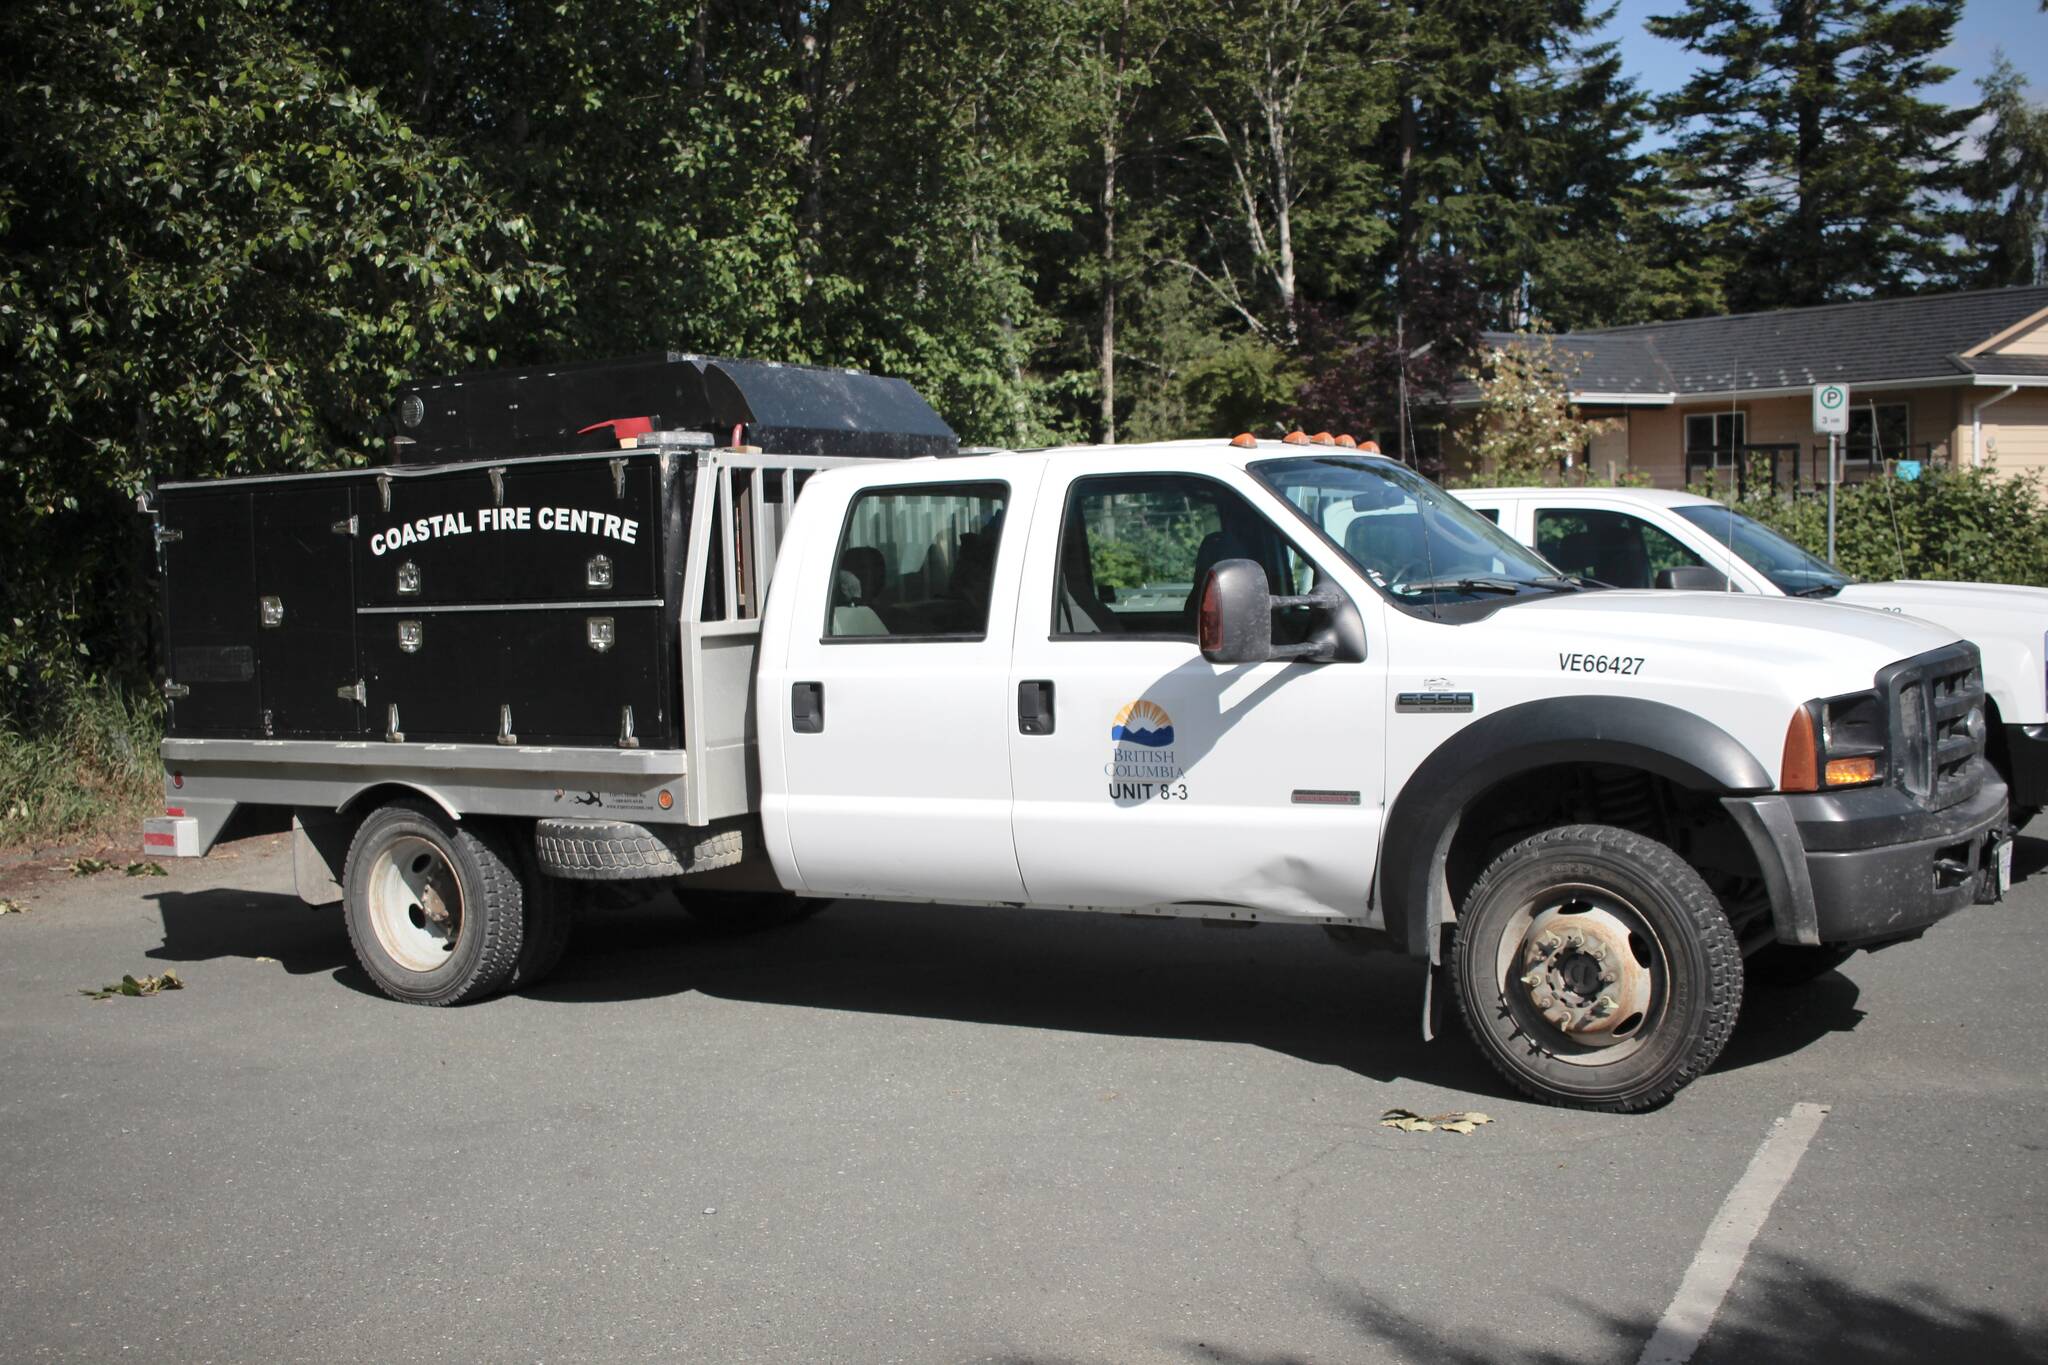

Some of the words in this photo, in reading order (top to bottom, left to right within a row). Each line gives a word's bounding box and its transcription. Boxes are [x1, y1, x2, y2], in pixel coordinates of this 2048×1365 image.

[1827, 391, 1838, 404] P
[370, 512, 473, 556] COASTAL
[478, 507, 531, 532] FIRE
[537, 507, 639, 545] CENTRE
[1559, 652, 1645, 676] VE66427
[1114, 749, 1174, 762] BRITISH
[1104, 763, 1186, 778] COLUMBIA
[1108, 783, 1153, 800] UNIT
[1160, 783, 1188, 800] 8-3
